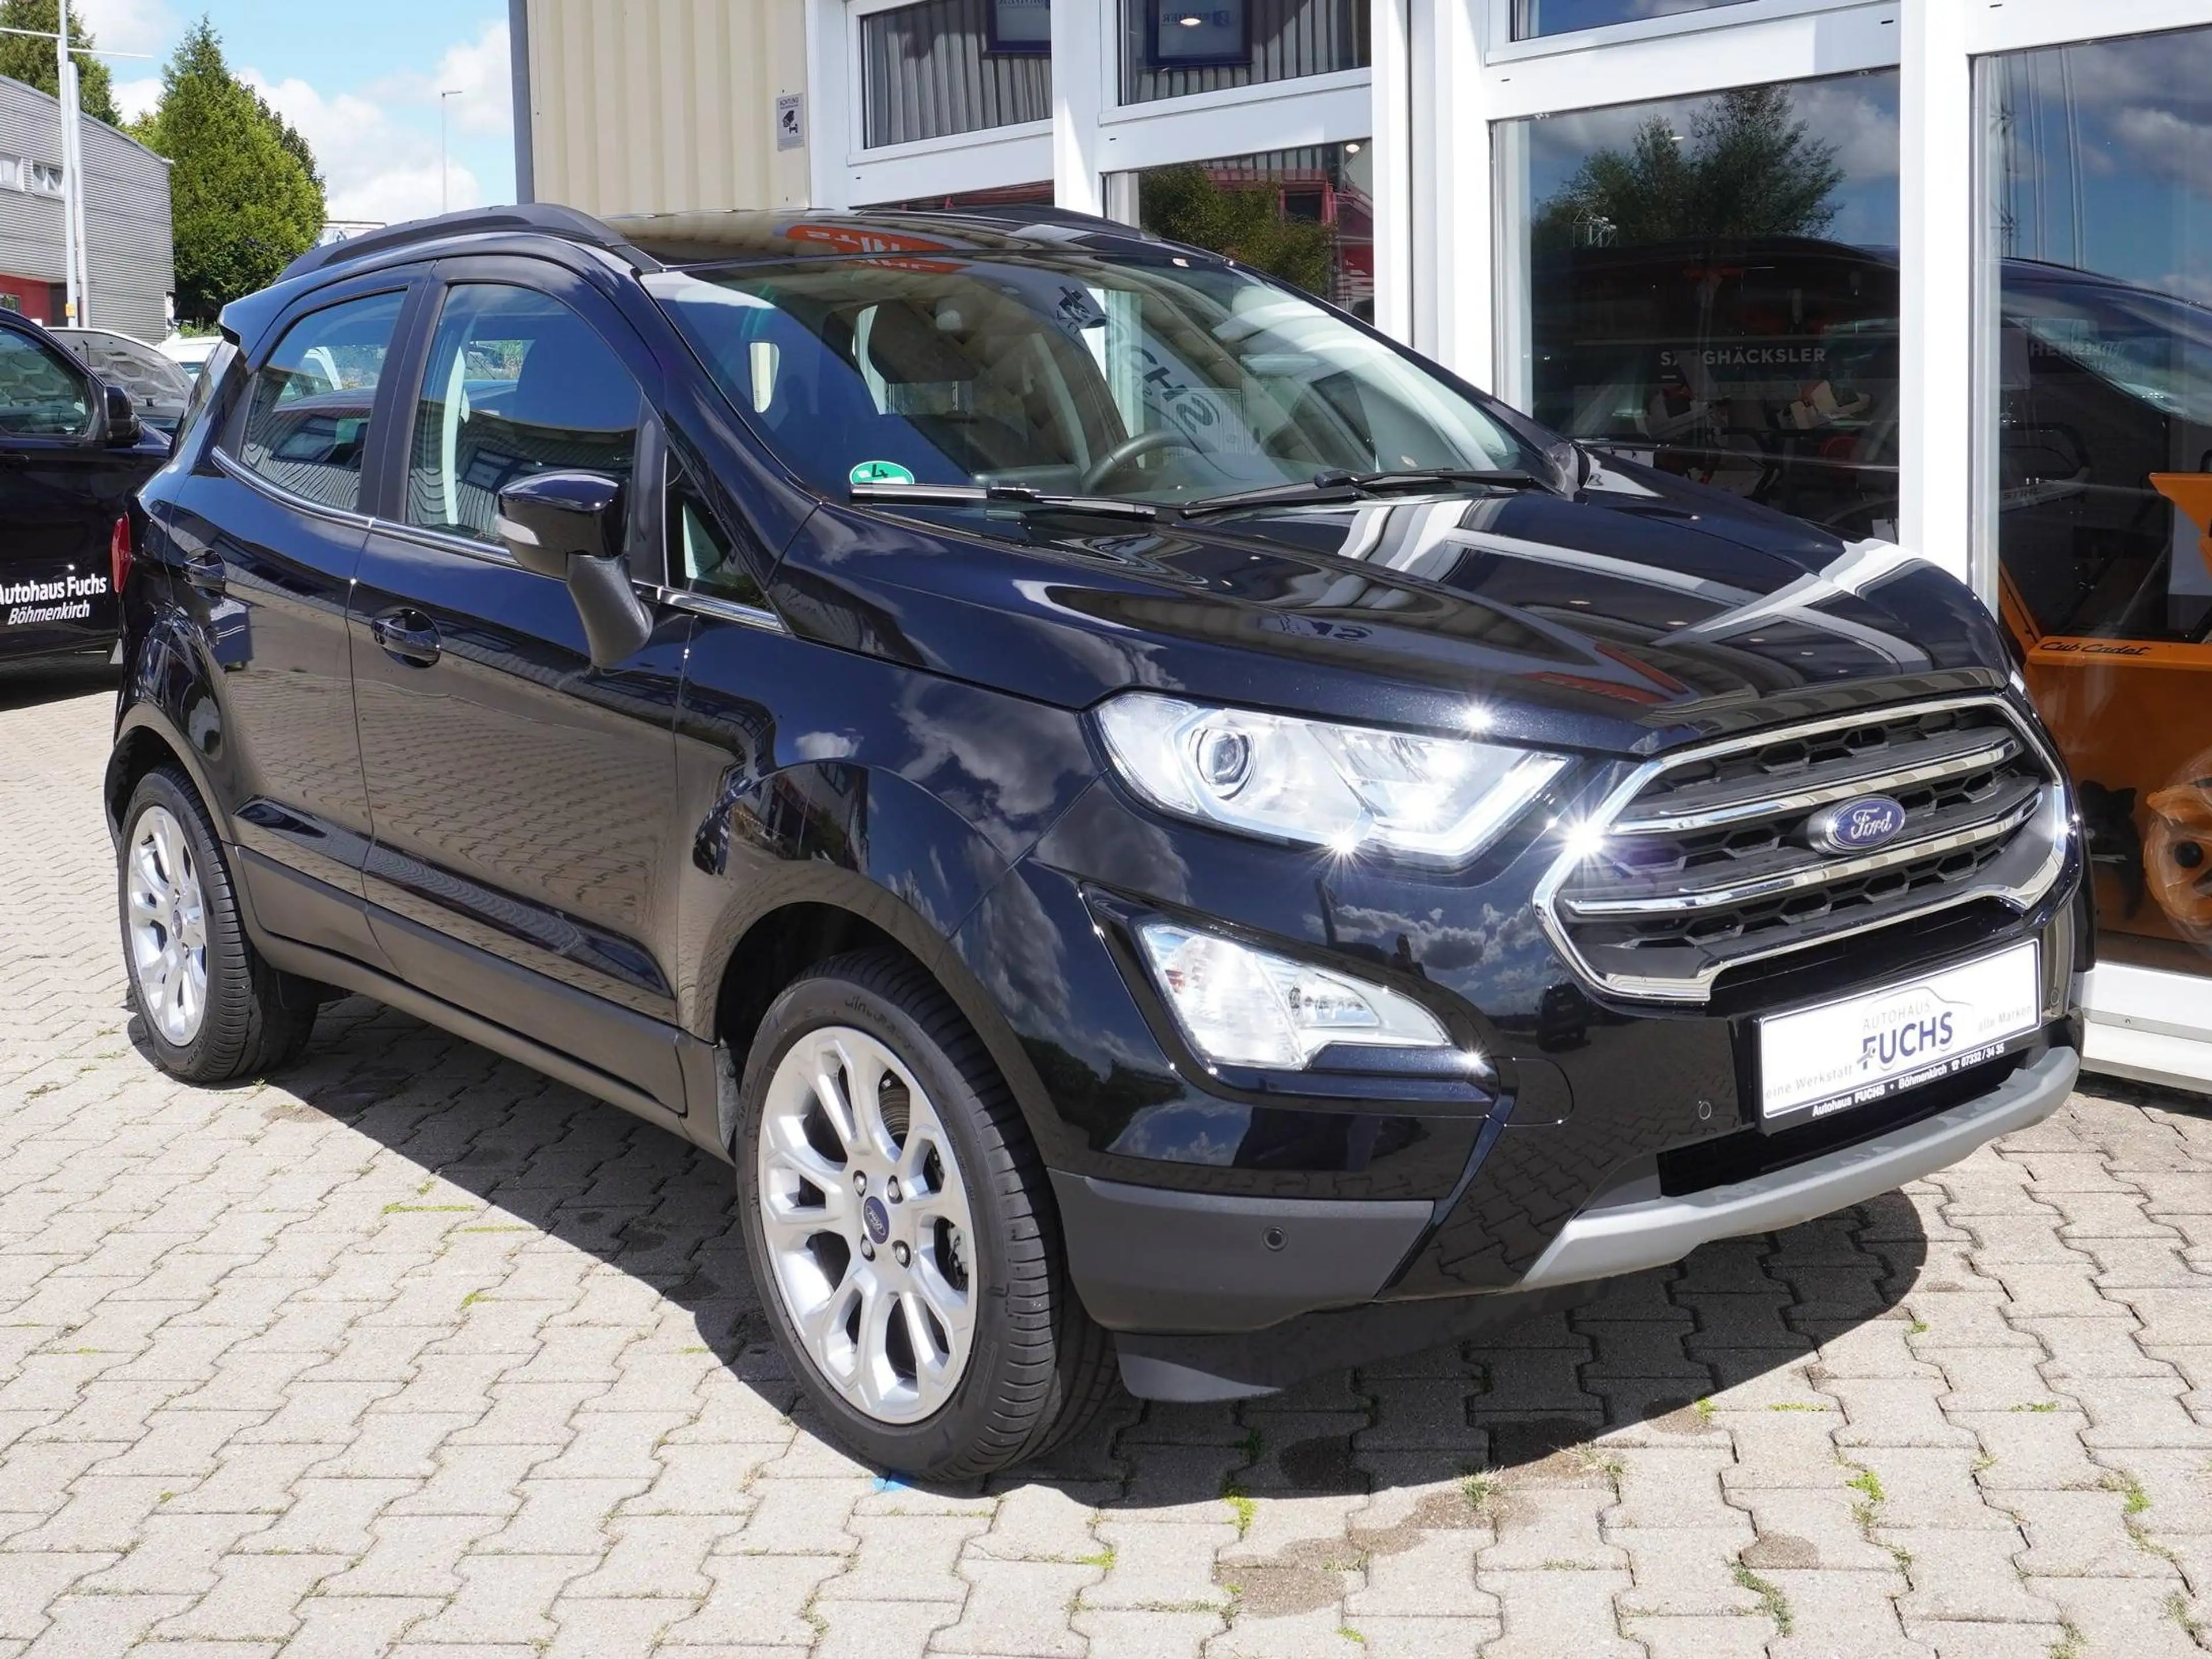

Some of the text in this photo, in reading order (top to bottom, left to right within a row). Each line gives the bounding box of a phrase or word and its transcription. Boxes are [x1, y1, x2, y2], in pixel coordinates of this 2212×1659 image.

[1660, 347, 1825, 366] SGHÄCKSLER
[67, 573, 107, 597] Fuchs
[7, 600, 90, 625] Böhmenkirch
[2040, 641, 2152, 656] Cub Cadet
[1850, 806, 1892, 839] Ford
[1863, 999, 1930, 1030] AUTOHAUS
[1862, 1011, 1953, 1070] FUCHS
[1795, 1065, 1852, 1090] Werkstatt
[1812, 1096, 1852, 1117] Autohaus
[1854, 1084, 1886, 1103] FUCHS
[1899, 1063, 1948, 1090] Böhmenkirch
